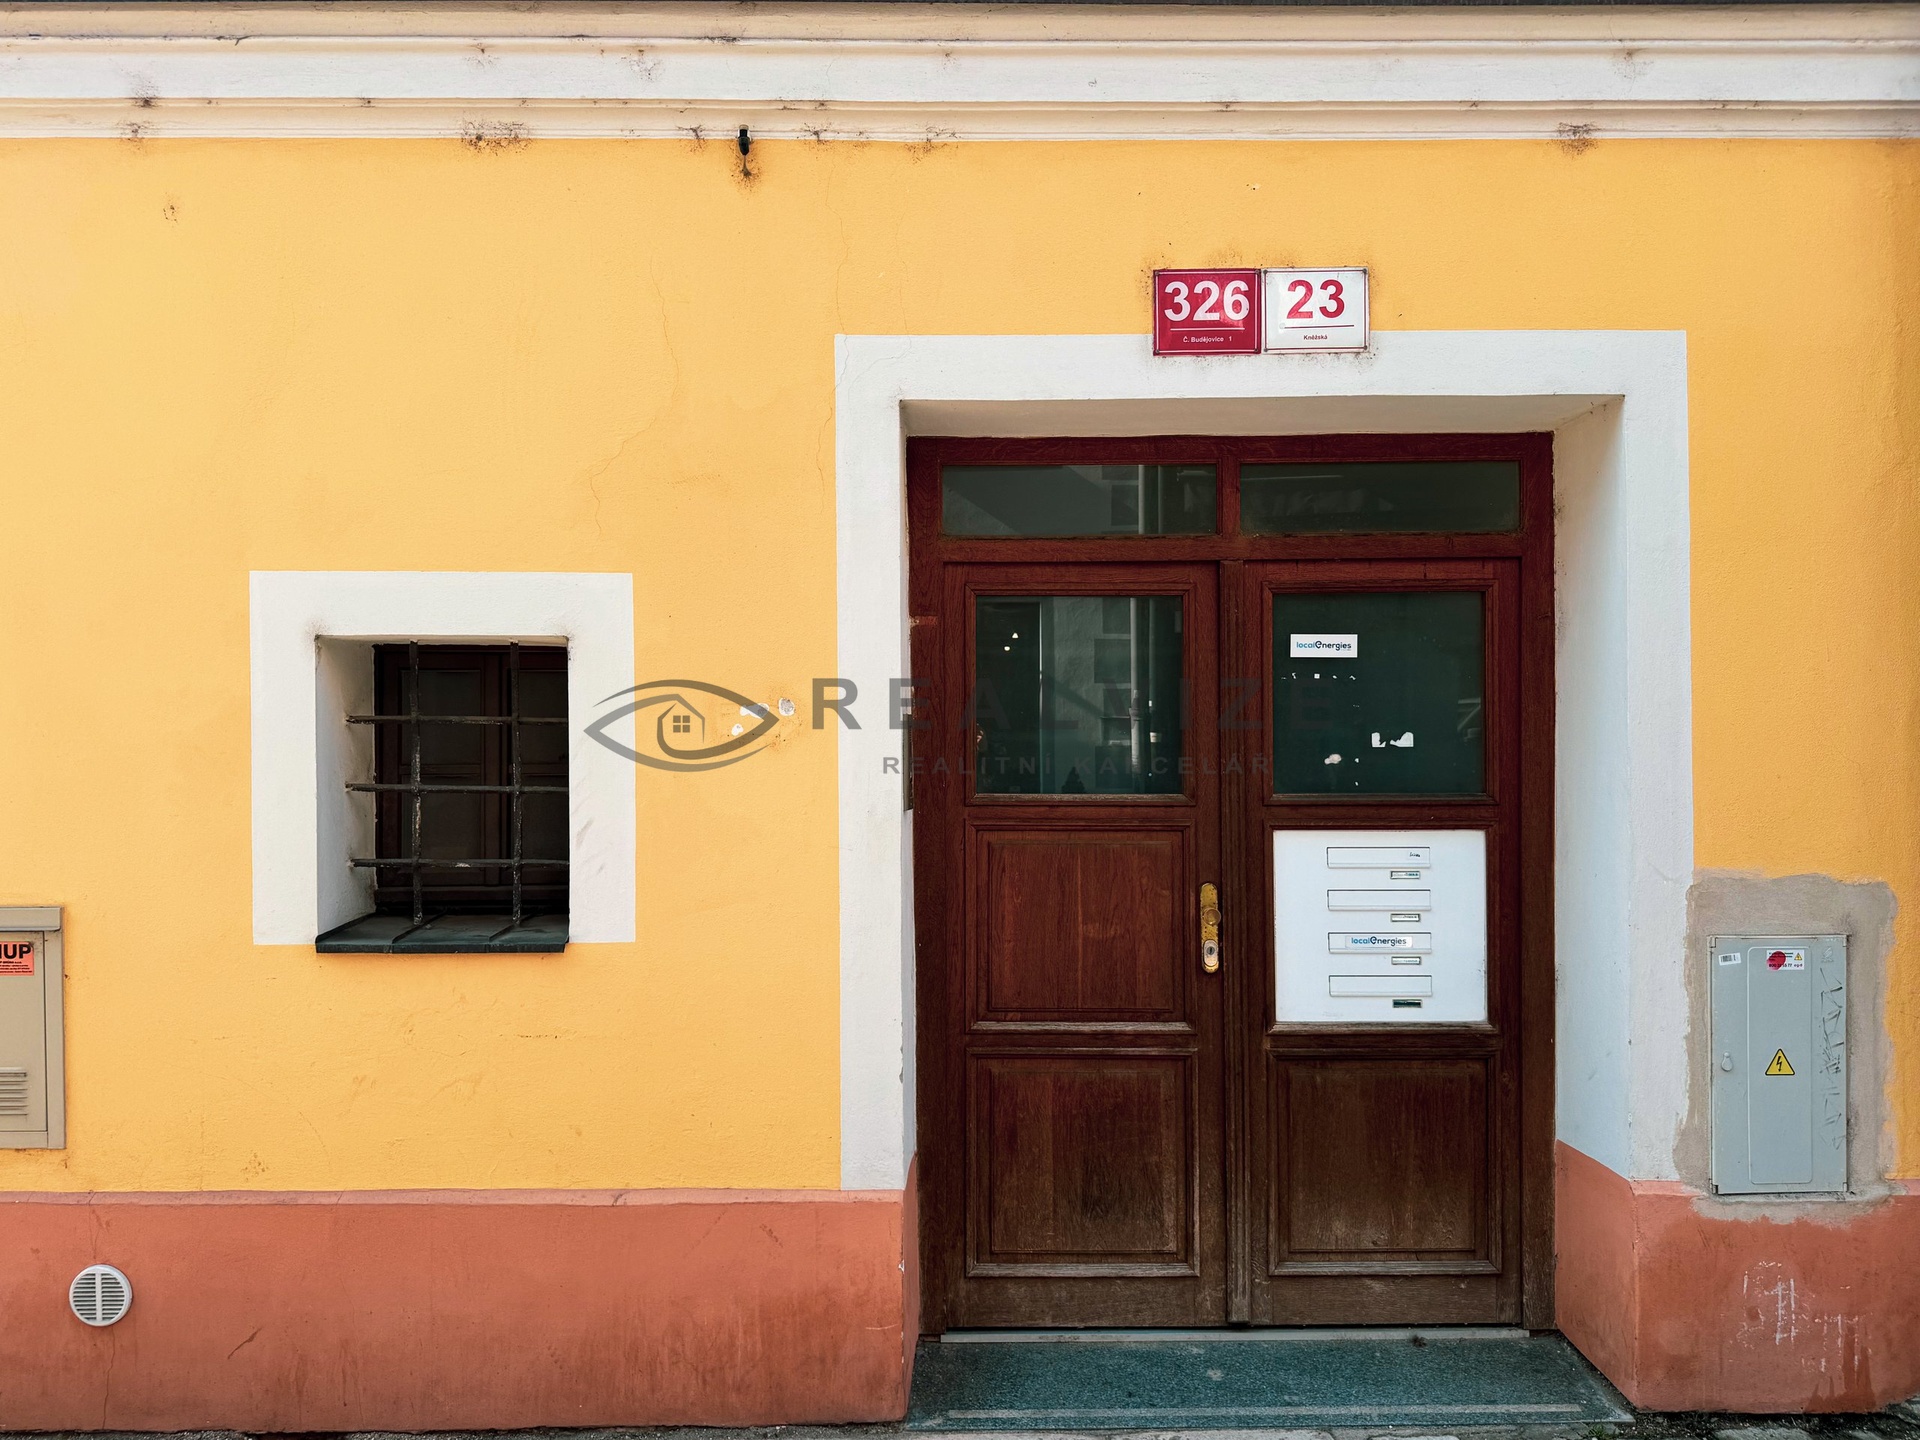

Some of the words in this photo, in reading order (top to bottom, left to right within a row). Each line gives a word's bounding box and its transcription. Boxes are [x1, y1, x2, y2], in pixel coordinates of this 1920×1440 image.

[1164, 280, 1250, 322] 326
[1286, 279, 1345, 319] 23
[0, 944, 31, 959] UP
